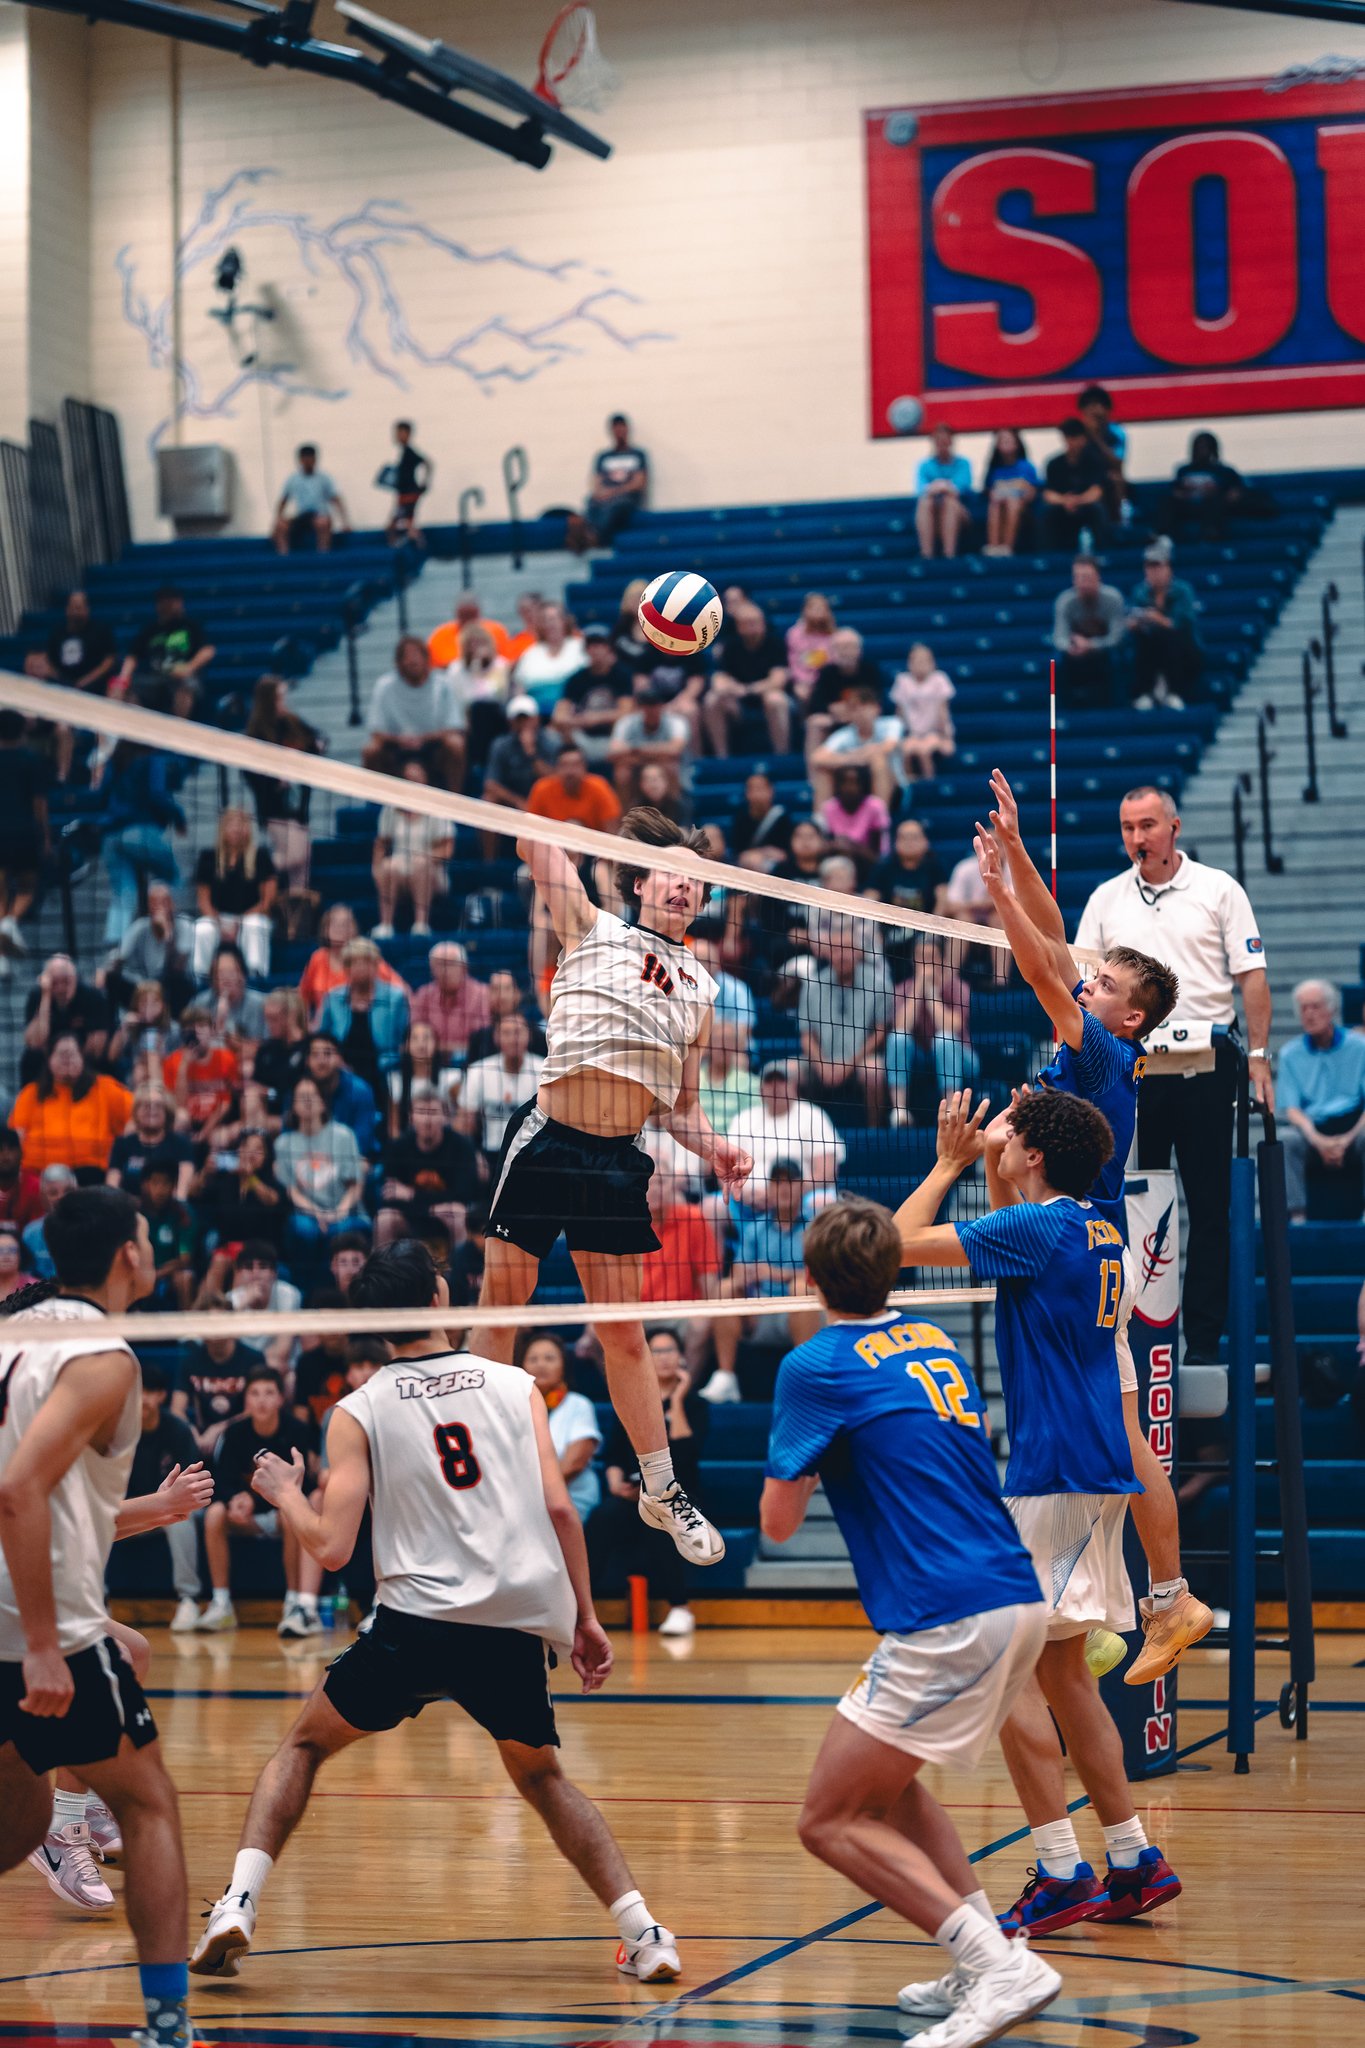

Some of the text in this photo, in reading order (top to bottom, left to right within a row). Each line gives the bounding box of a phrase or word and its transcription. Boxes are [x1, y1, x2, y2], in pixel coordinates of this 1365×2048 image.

[1096, 1258, 1121, 1328] 13
[396, 1369, 485, 1399] TIGERS
[905, 1357, 980, 1428] 12
[1148, 1343, 1173, 1476] SOU
[433, 1421, 482, 1490] 8
